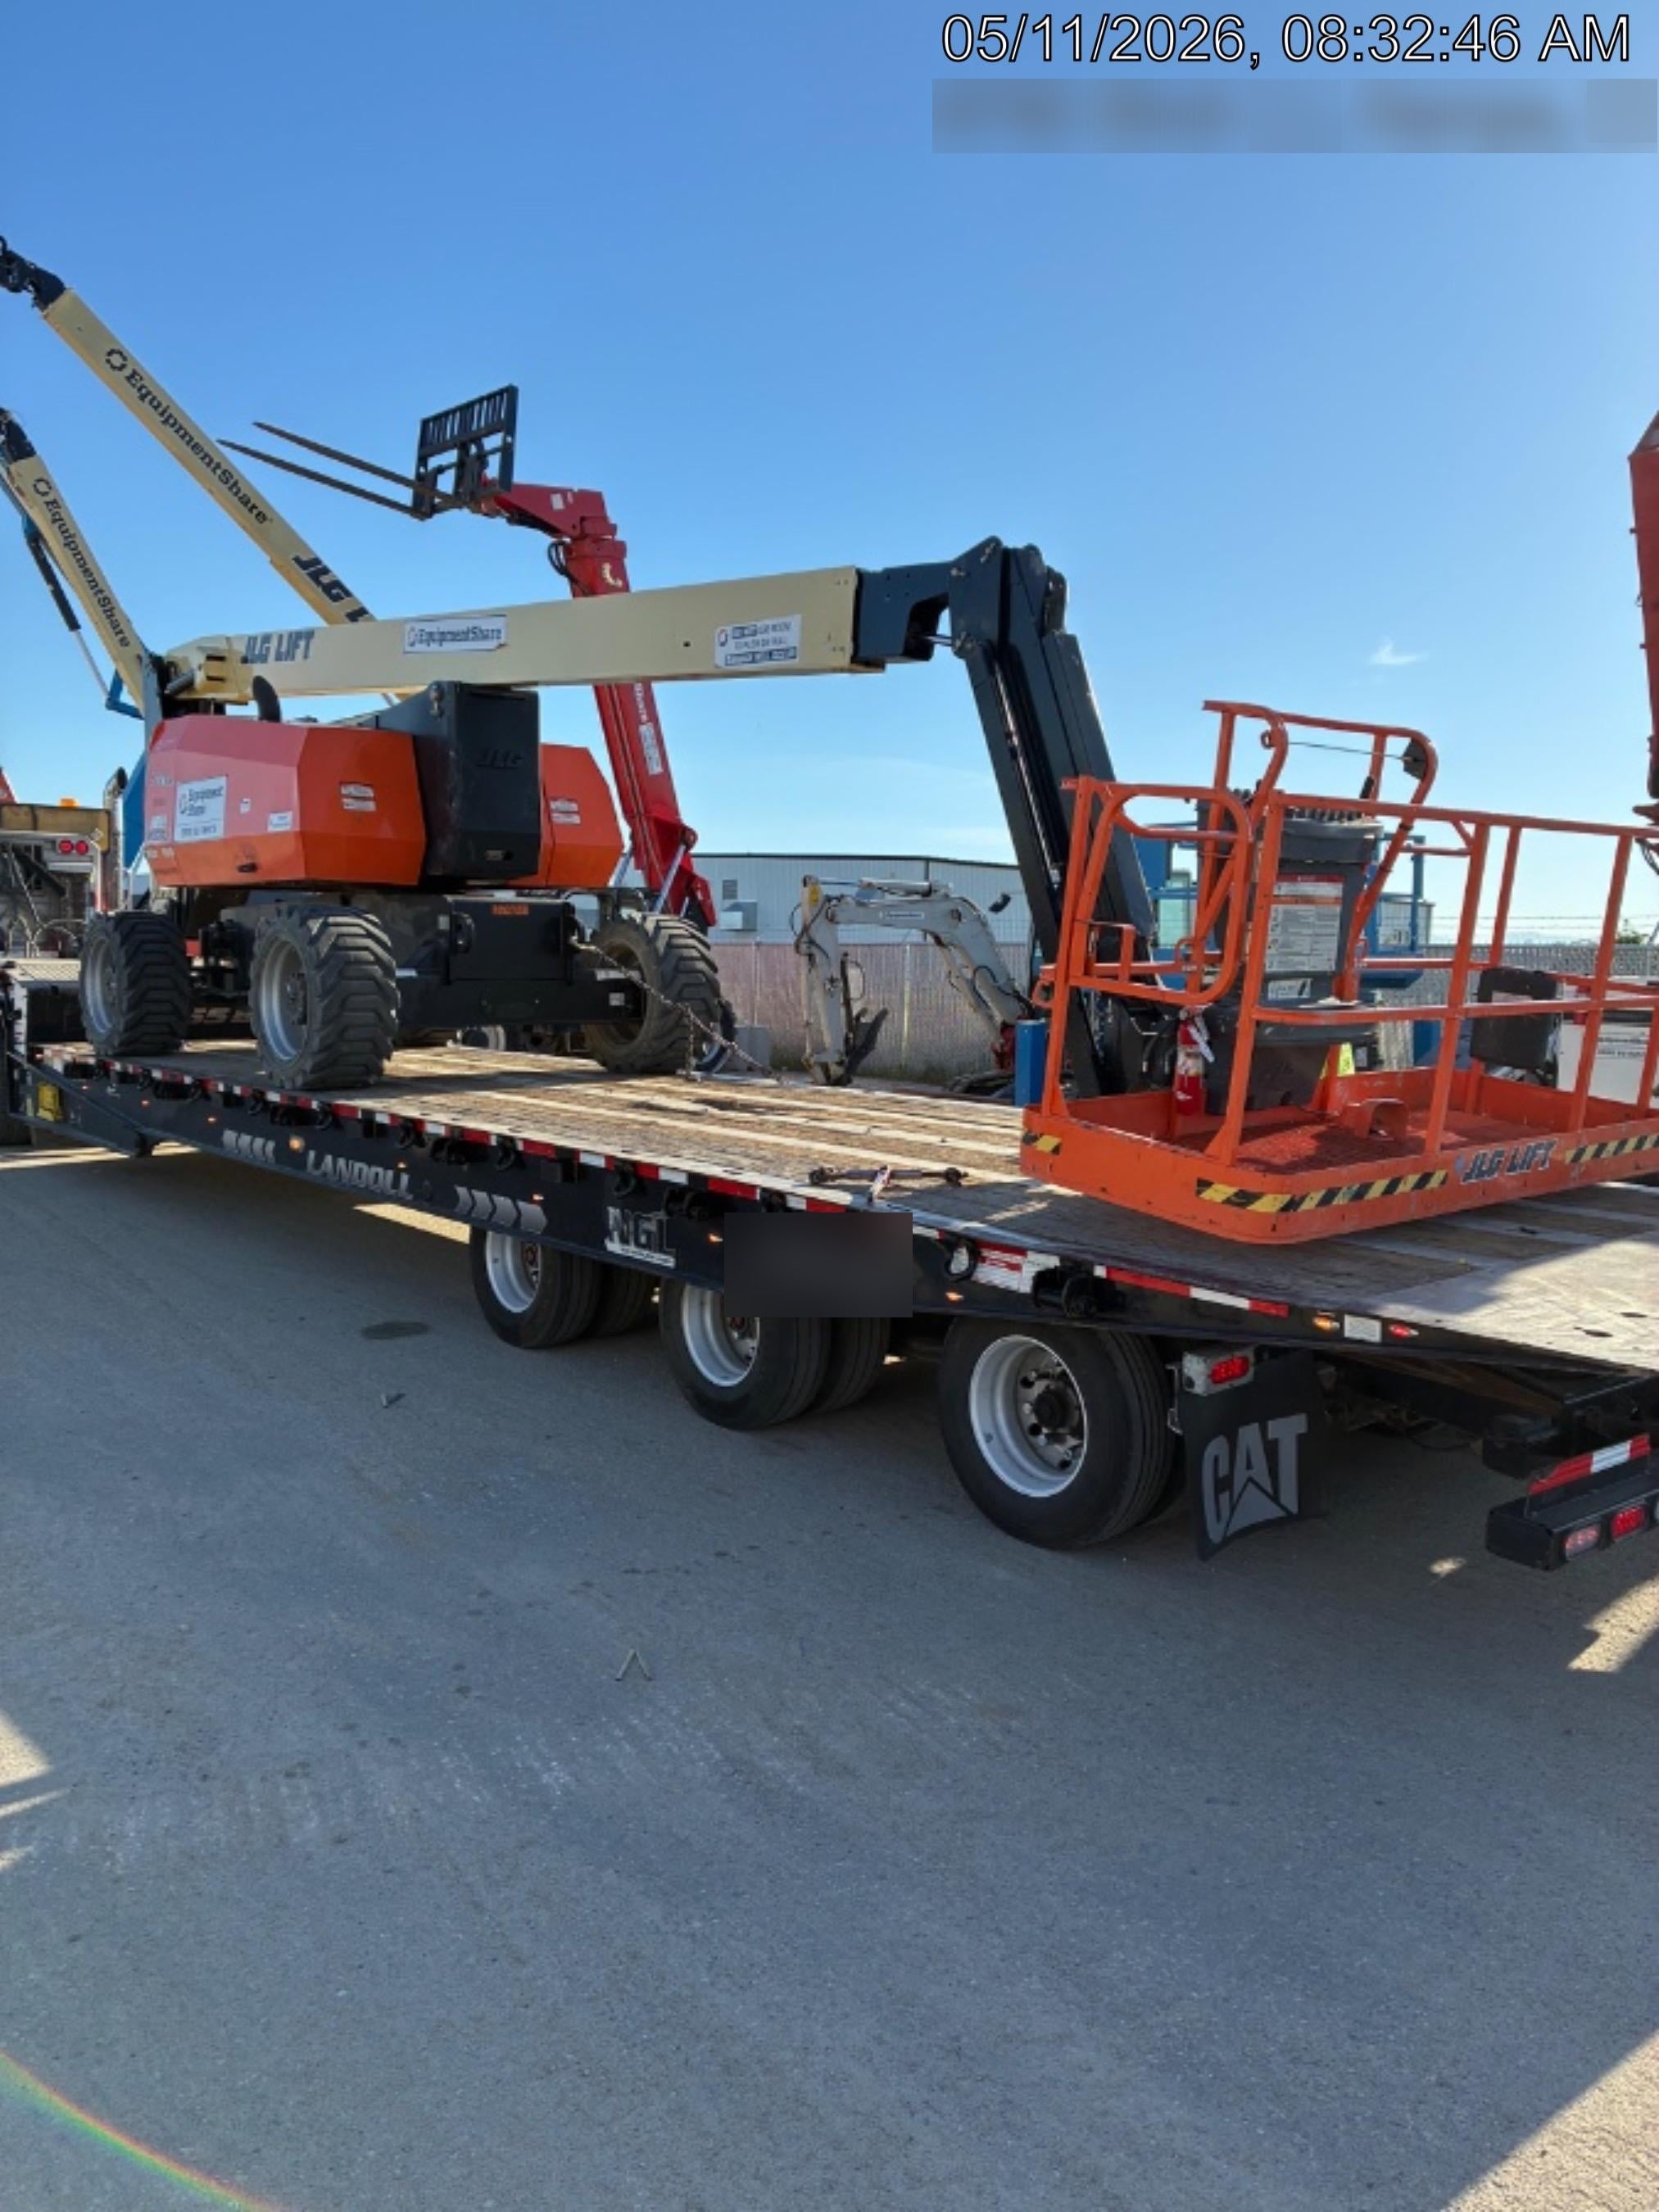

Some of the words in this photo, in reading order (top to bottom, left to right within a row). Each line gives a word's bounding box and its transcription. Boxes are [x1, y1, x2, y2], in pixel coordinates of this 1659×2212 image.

[124, 368, 269, 524] EquipmentShare
[43, 497, 130, 648] EquipmentShare
[292, 555, 354, 603] JLG
[274, 628, 315, 662] LIFT
[306, 1149, 414, 1201] LANDOLL
[1460, 1147, 1507, 1185] JLG
[1505, 1139, 1557, 1176] LIFT
[1202, 1413, 1308, 1545] CAT
